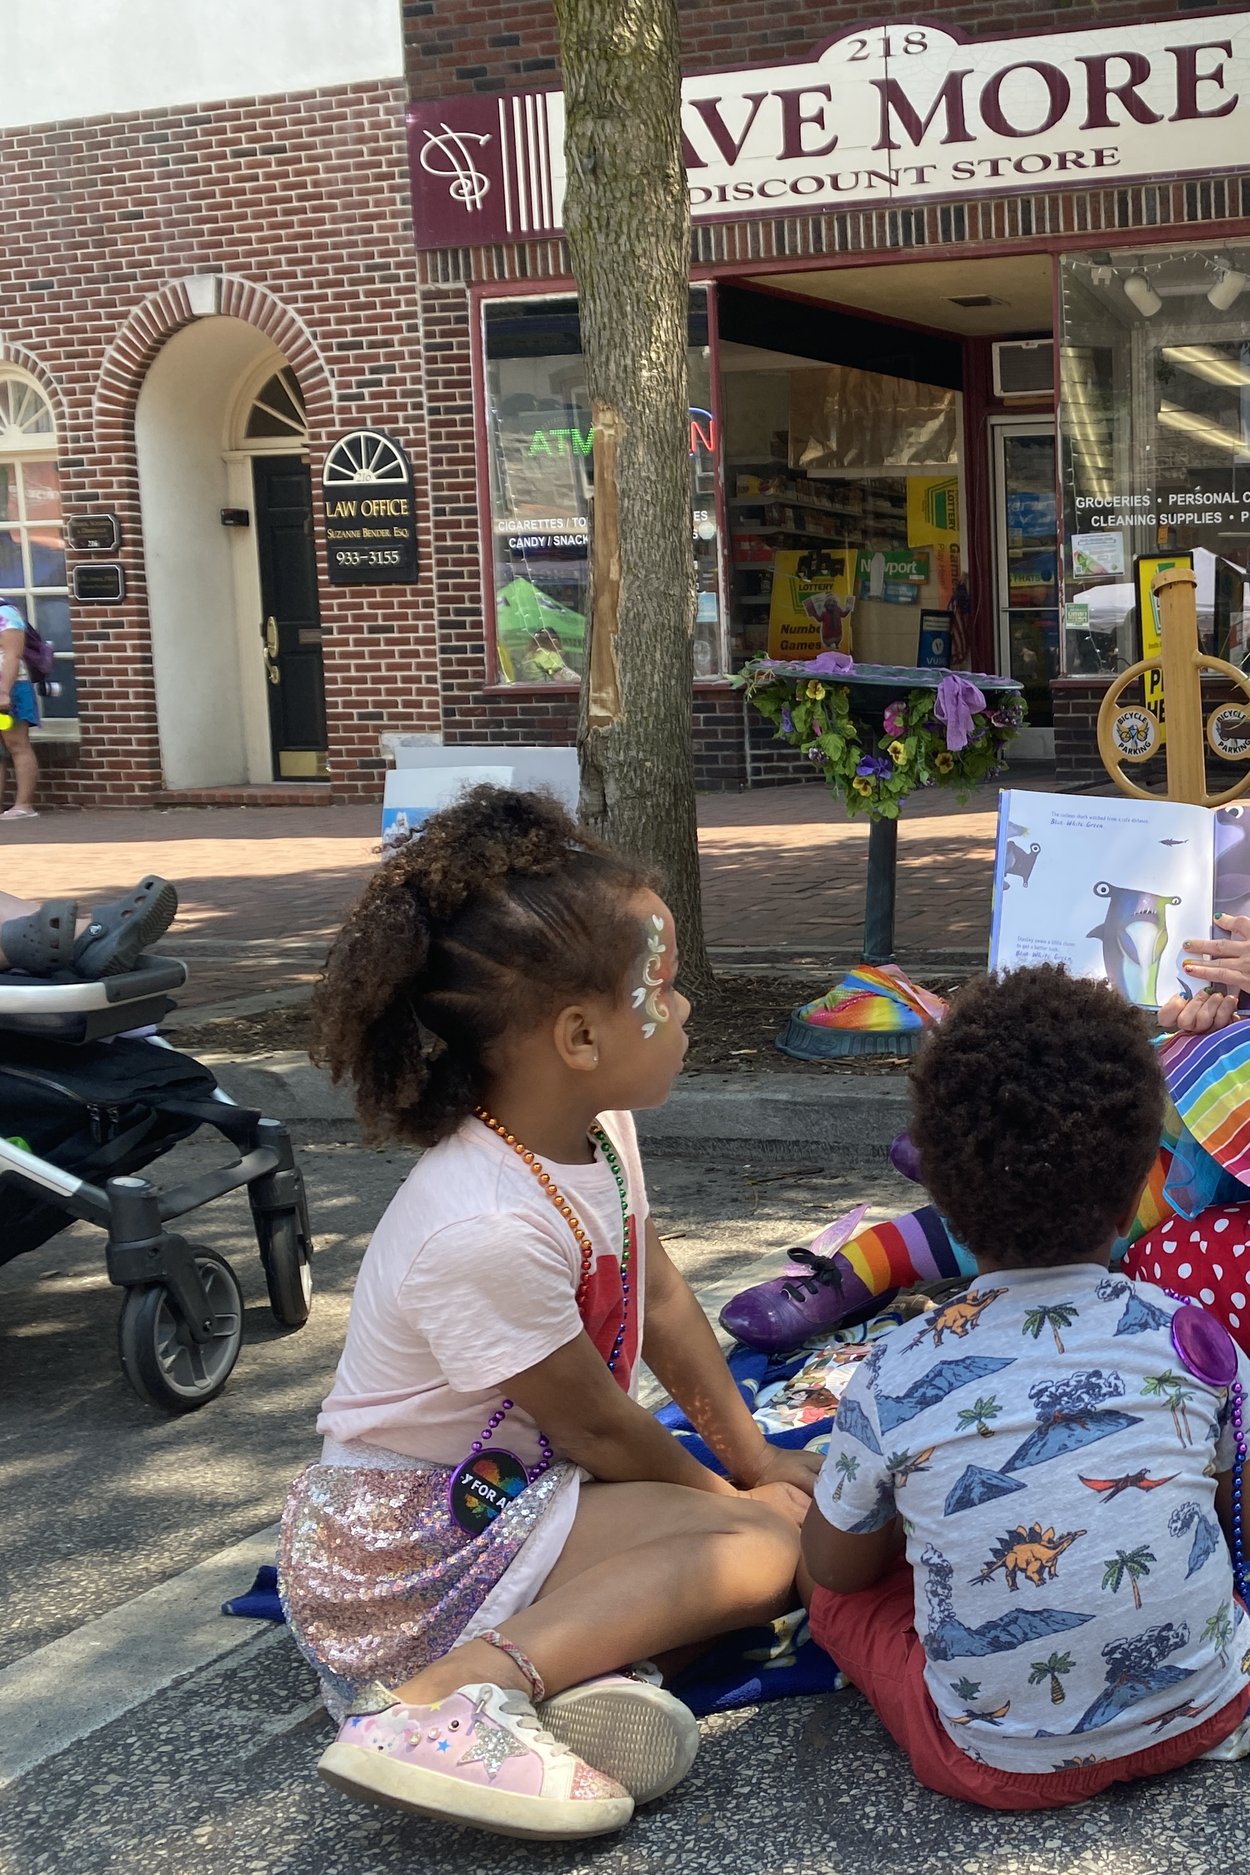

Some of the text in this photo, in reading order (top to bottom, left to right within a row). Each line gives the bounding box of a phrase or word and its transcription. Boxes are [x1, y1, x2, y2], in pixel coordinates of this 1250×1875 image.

[847, 31, 929, 61] 218
[870, 39, 1240, 152] MORE
[687, 146, 1121, 205] DISCOUNT STORE
[528, 426, 594, 457] ATM
[325, 498, 410, 518] LAW OFFICE
[1076, 495, 1151, 508] GROCERIES
[1168, 492, 1240, 506] PERSONAL
[947, 490, 956, 532] LOTTERY
[498, 518, 564, 532] CIGARETTES
[1091, 513, 1157, 527] CLEANING
[1160, 512, 1223, 525] SUPPLIES
[508, 536, 545, 549] CANDY
[336, 550, 400, 566] 933-3155
[861, 558, 917, 576] Nport
[799, 583, 834, 592] LOTTERY
[780, 639, 822, 651] Games
[1117, 712, 1148, 725] BICYCLE
[1118, 740, 1151, 755] PARKING
[470, 1480, 497, 1502] FOR
